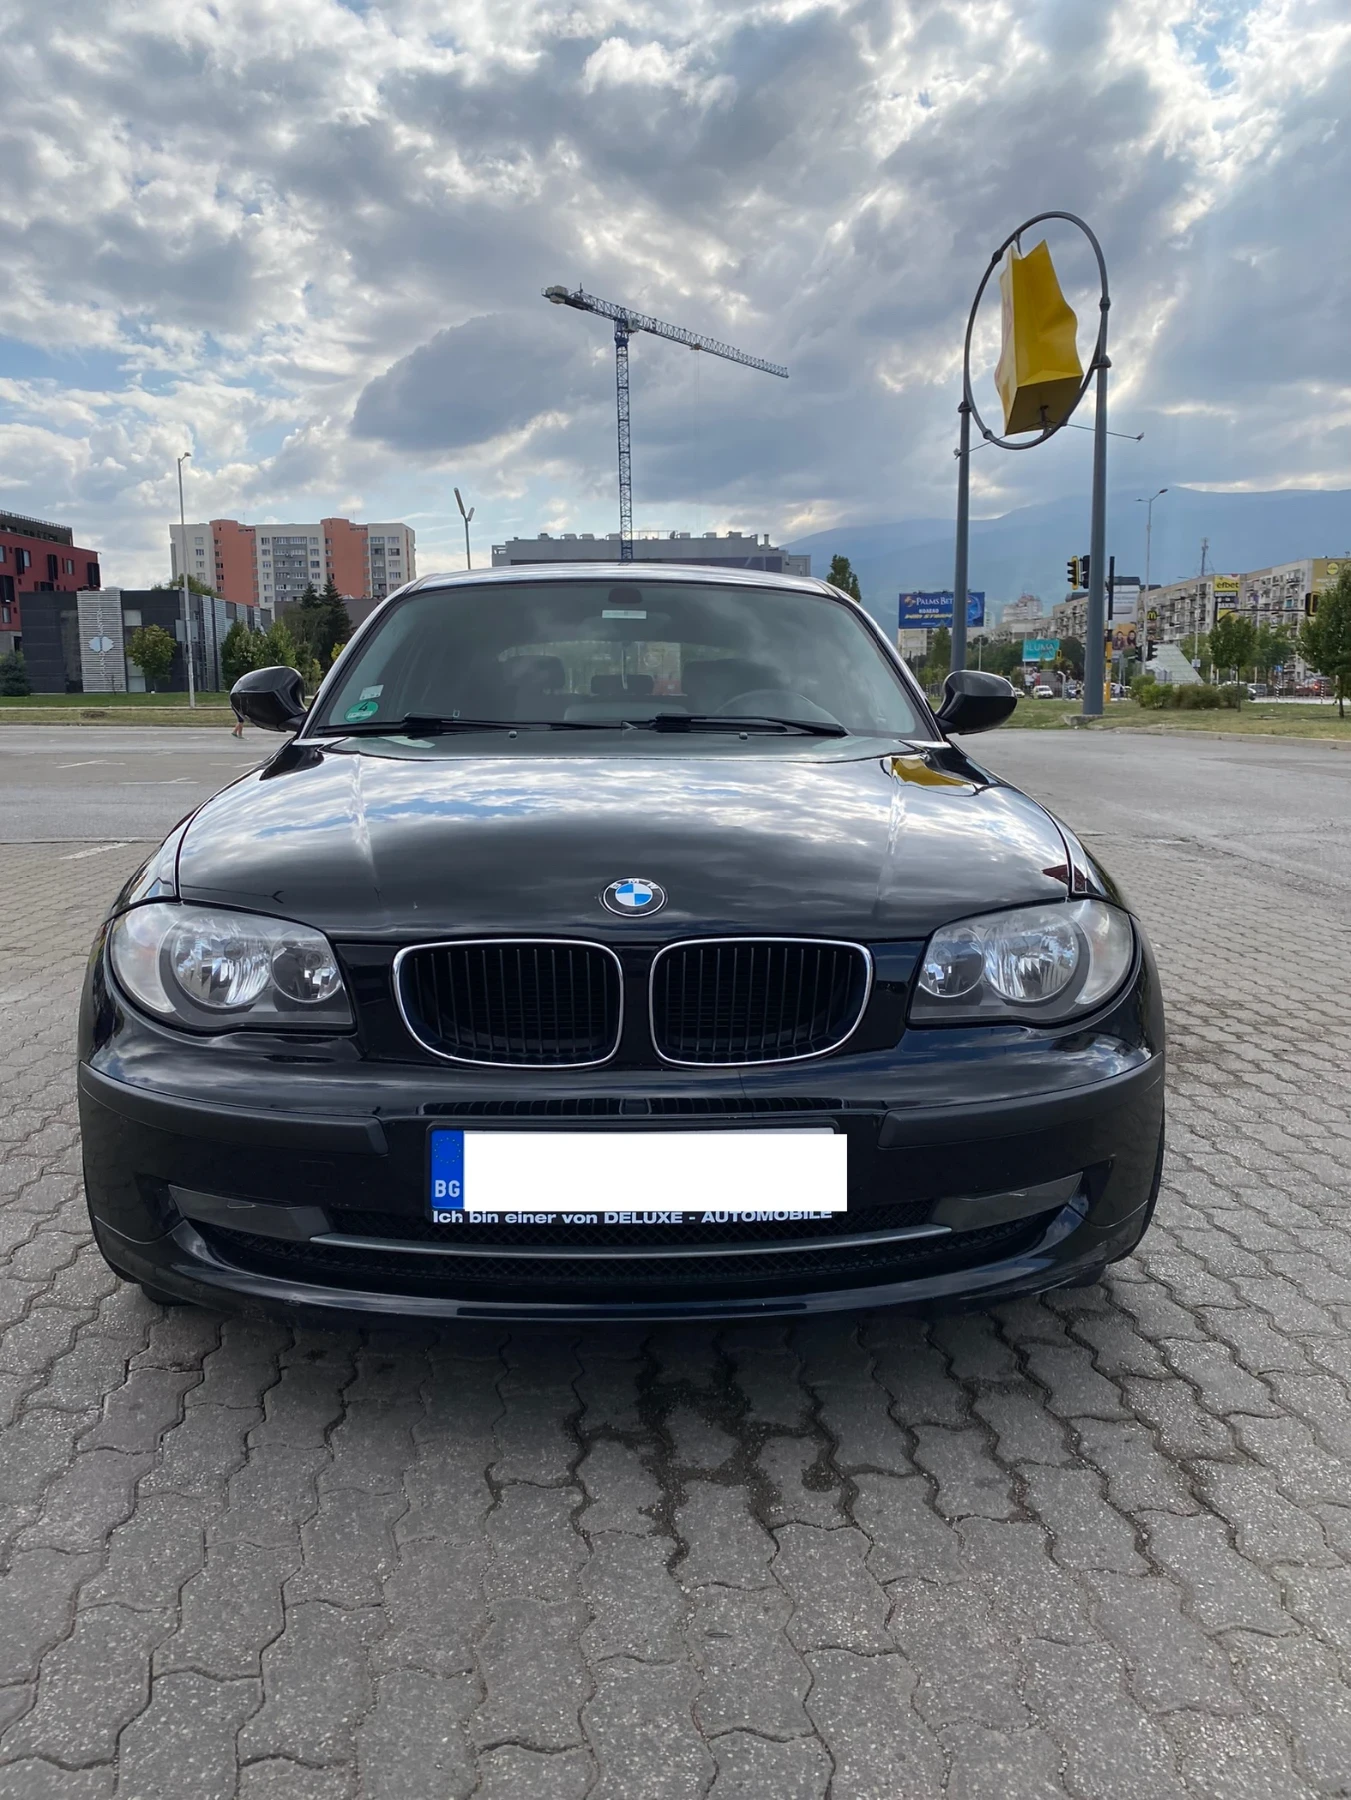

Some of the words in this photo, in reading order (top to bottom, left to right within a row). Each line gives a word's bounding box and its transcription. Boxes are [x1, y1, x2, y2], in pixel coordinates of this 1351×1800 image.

[358, 701, 368, 711] 4
[435, 1180, 460, 1198] BG
[433, 1211, 463, 1223] Ich
[470, 1211, 499, 1223] bin
[505, 1211, 557, 1224] einer
[561, 1213, 597, 1224] von
[604, 1212, 683, 1224] DELUXE
[701, 1211, 832, 1223] AUTOMOBILE
